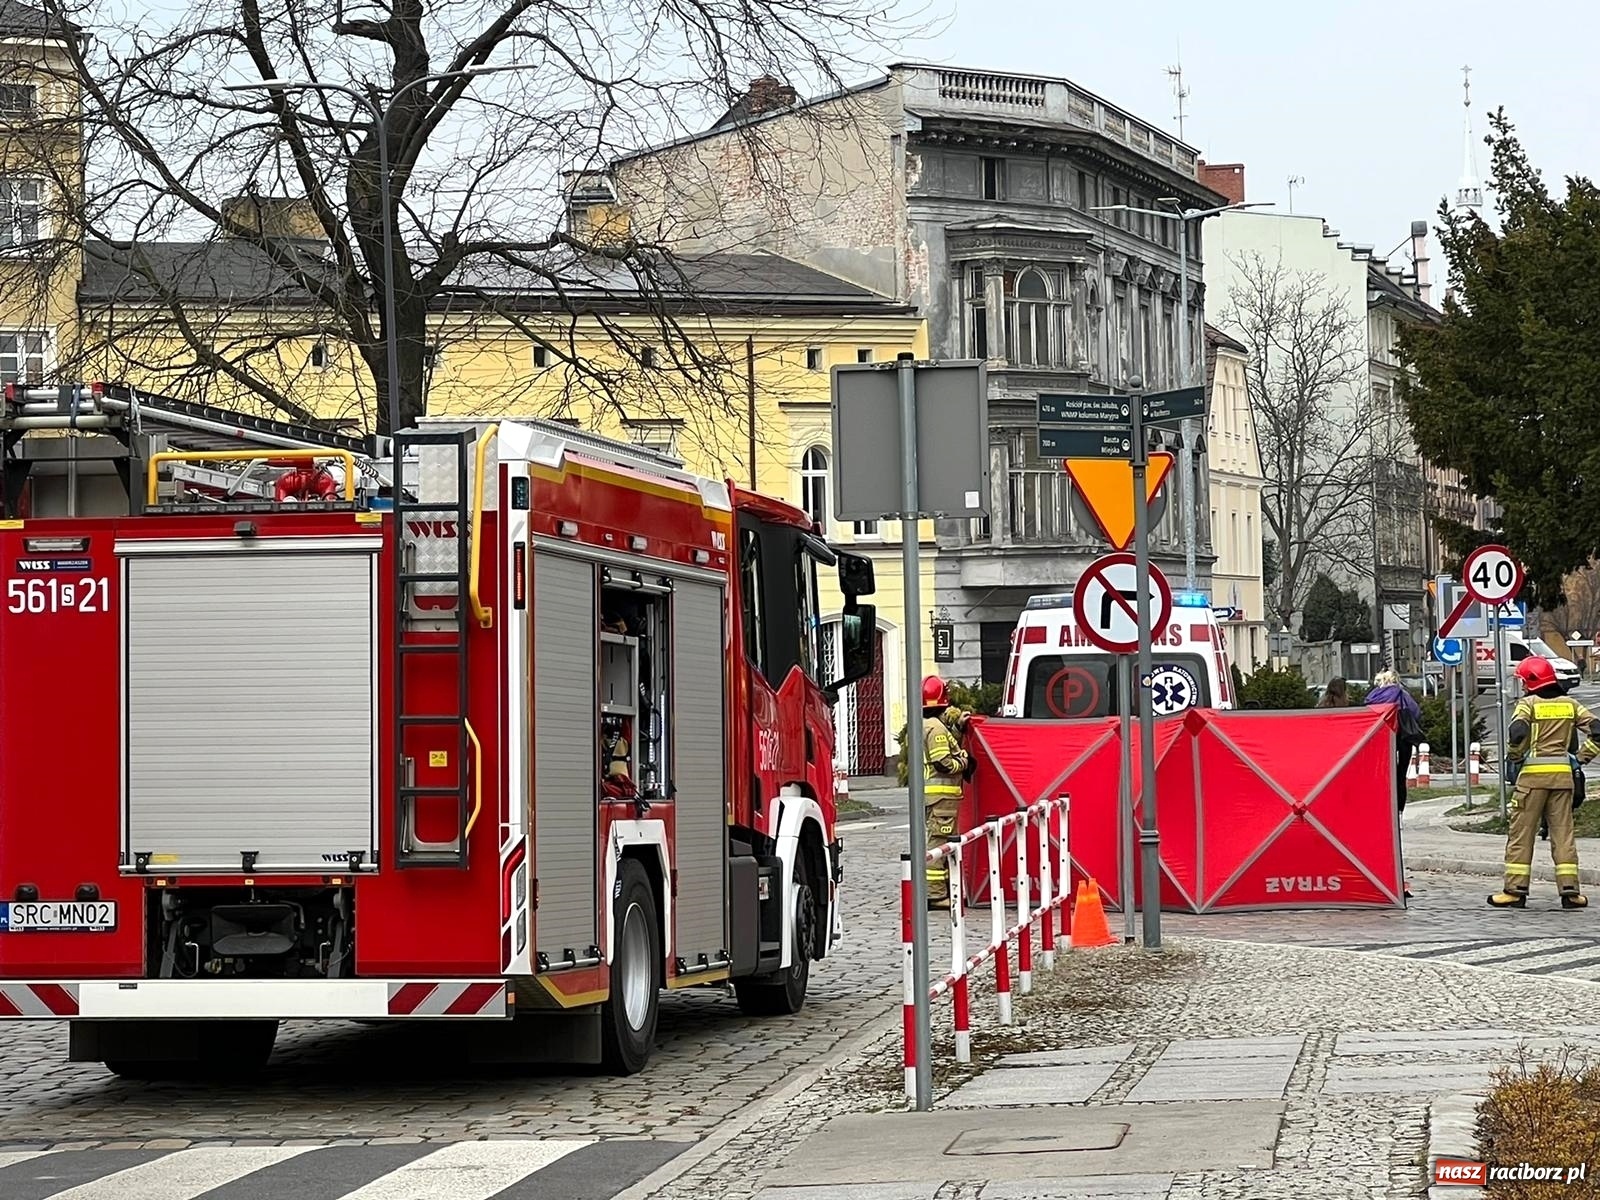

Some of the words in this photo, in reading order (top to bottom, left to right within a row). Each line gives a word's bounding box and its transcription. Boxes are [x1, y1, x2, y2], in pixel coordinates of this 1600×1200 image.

[406, 521, 470, 538] WIS
[19, 561, 50, 569] WISS
[1472, 560, 1513, 589] 40
[13, 904, 51, 924] SRC
